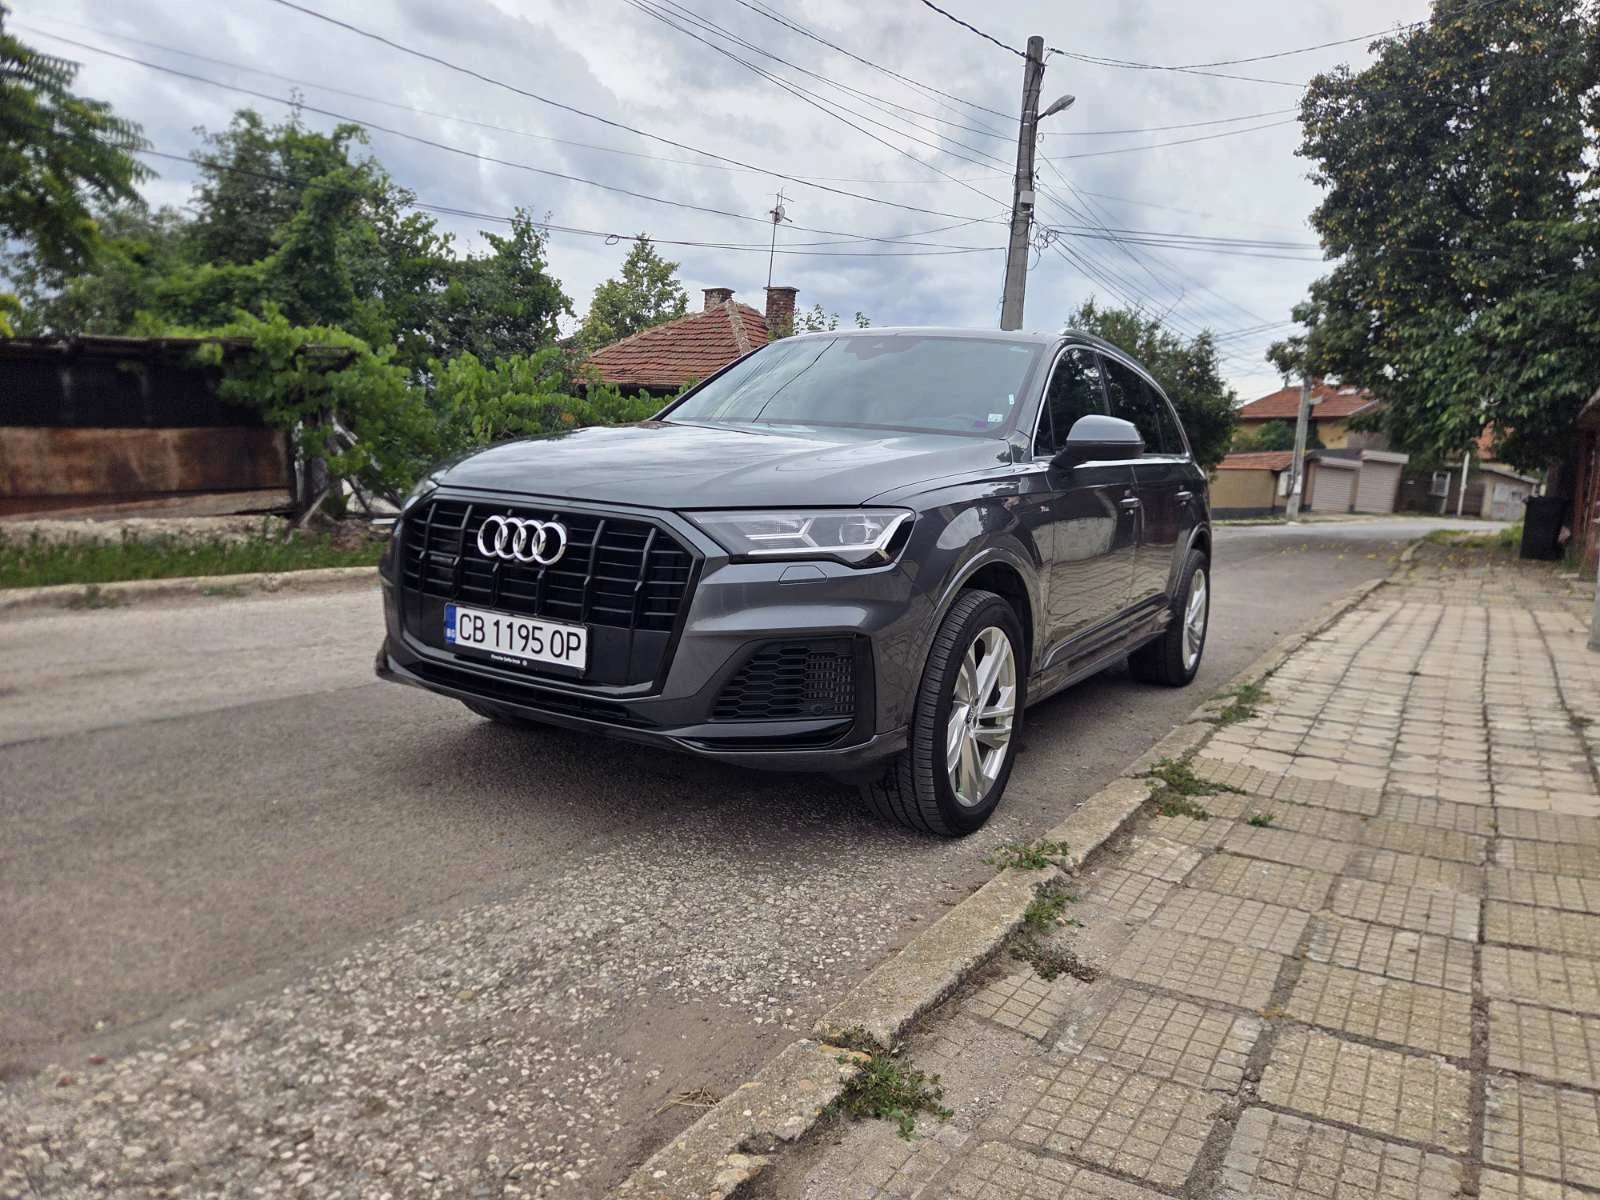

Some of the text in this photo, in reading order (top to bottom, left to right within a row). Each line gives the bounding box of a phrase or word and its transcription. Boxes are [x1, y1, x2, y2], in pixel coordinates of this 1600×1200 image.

[460, 614, 581, 660] CB 1195 OP
